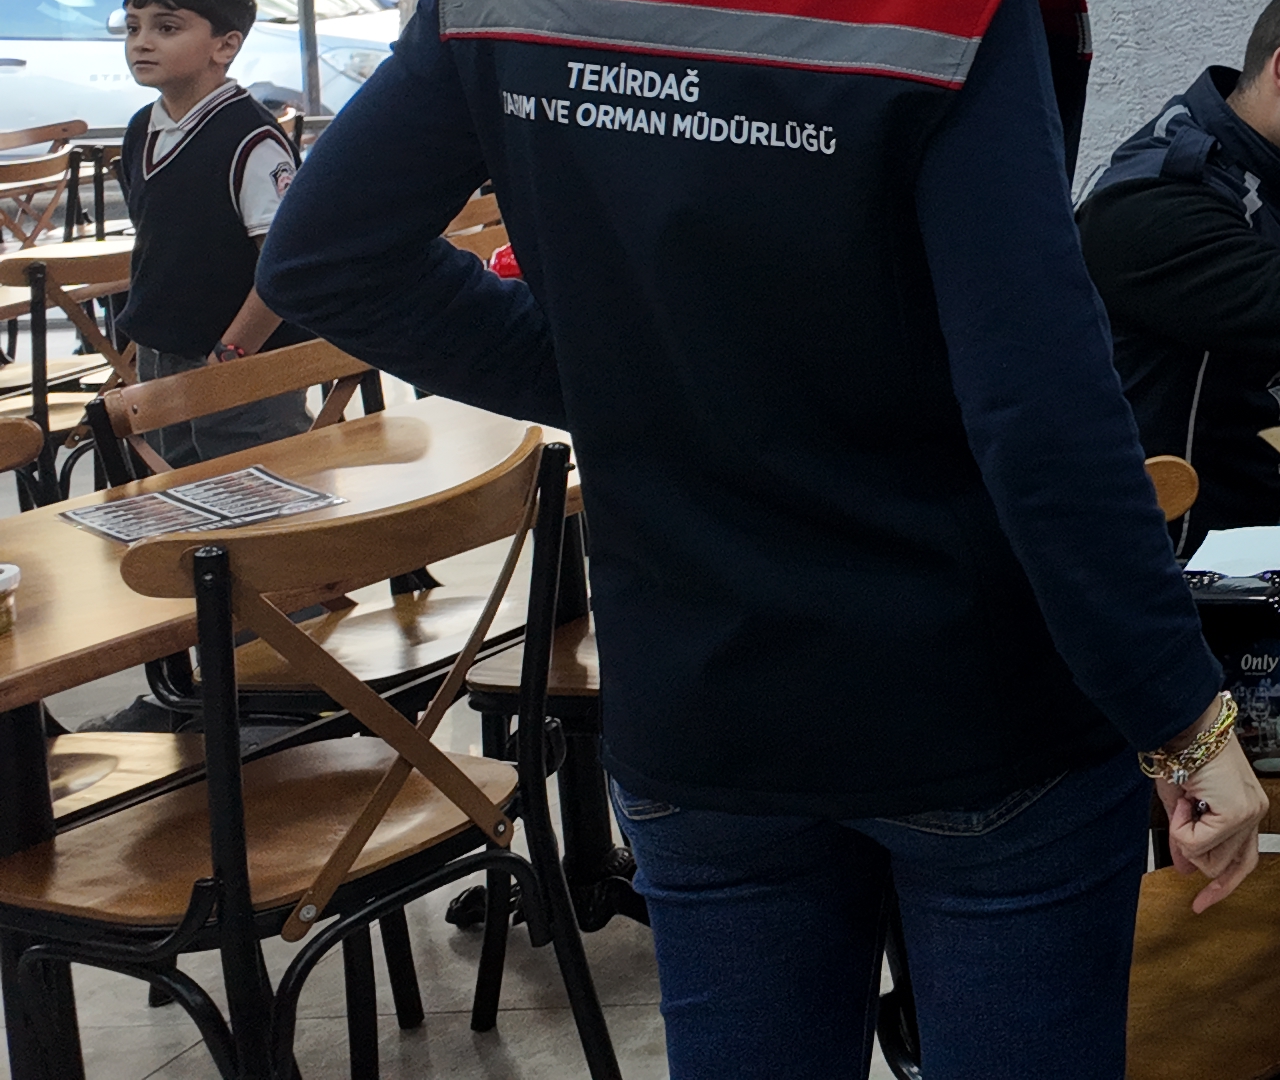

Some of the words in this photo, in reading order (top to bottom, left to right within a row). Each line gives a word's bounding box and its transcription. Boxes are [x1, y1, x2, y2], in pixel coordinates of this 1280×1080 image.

[567, 61, 700, 103] TEKİRDAĞ
[541, 97, 570, 124] VE
[575, 102, 667, 136] ORMAN
[672, 110, 837, 155] MÜDÜRLÜĞÜ
[1240, 653, 1280, 673] Only
